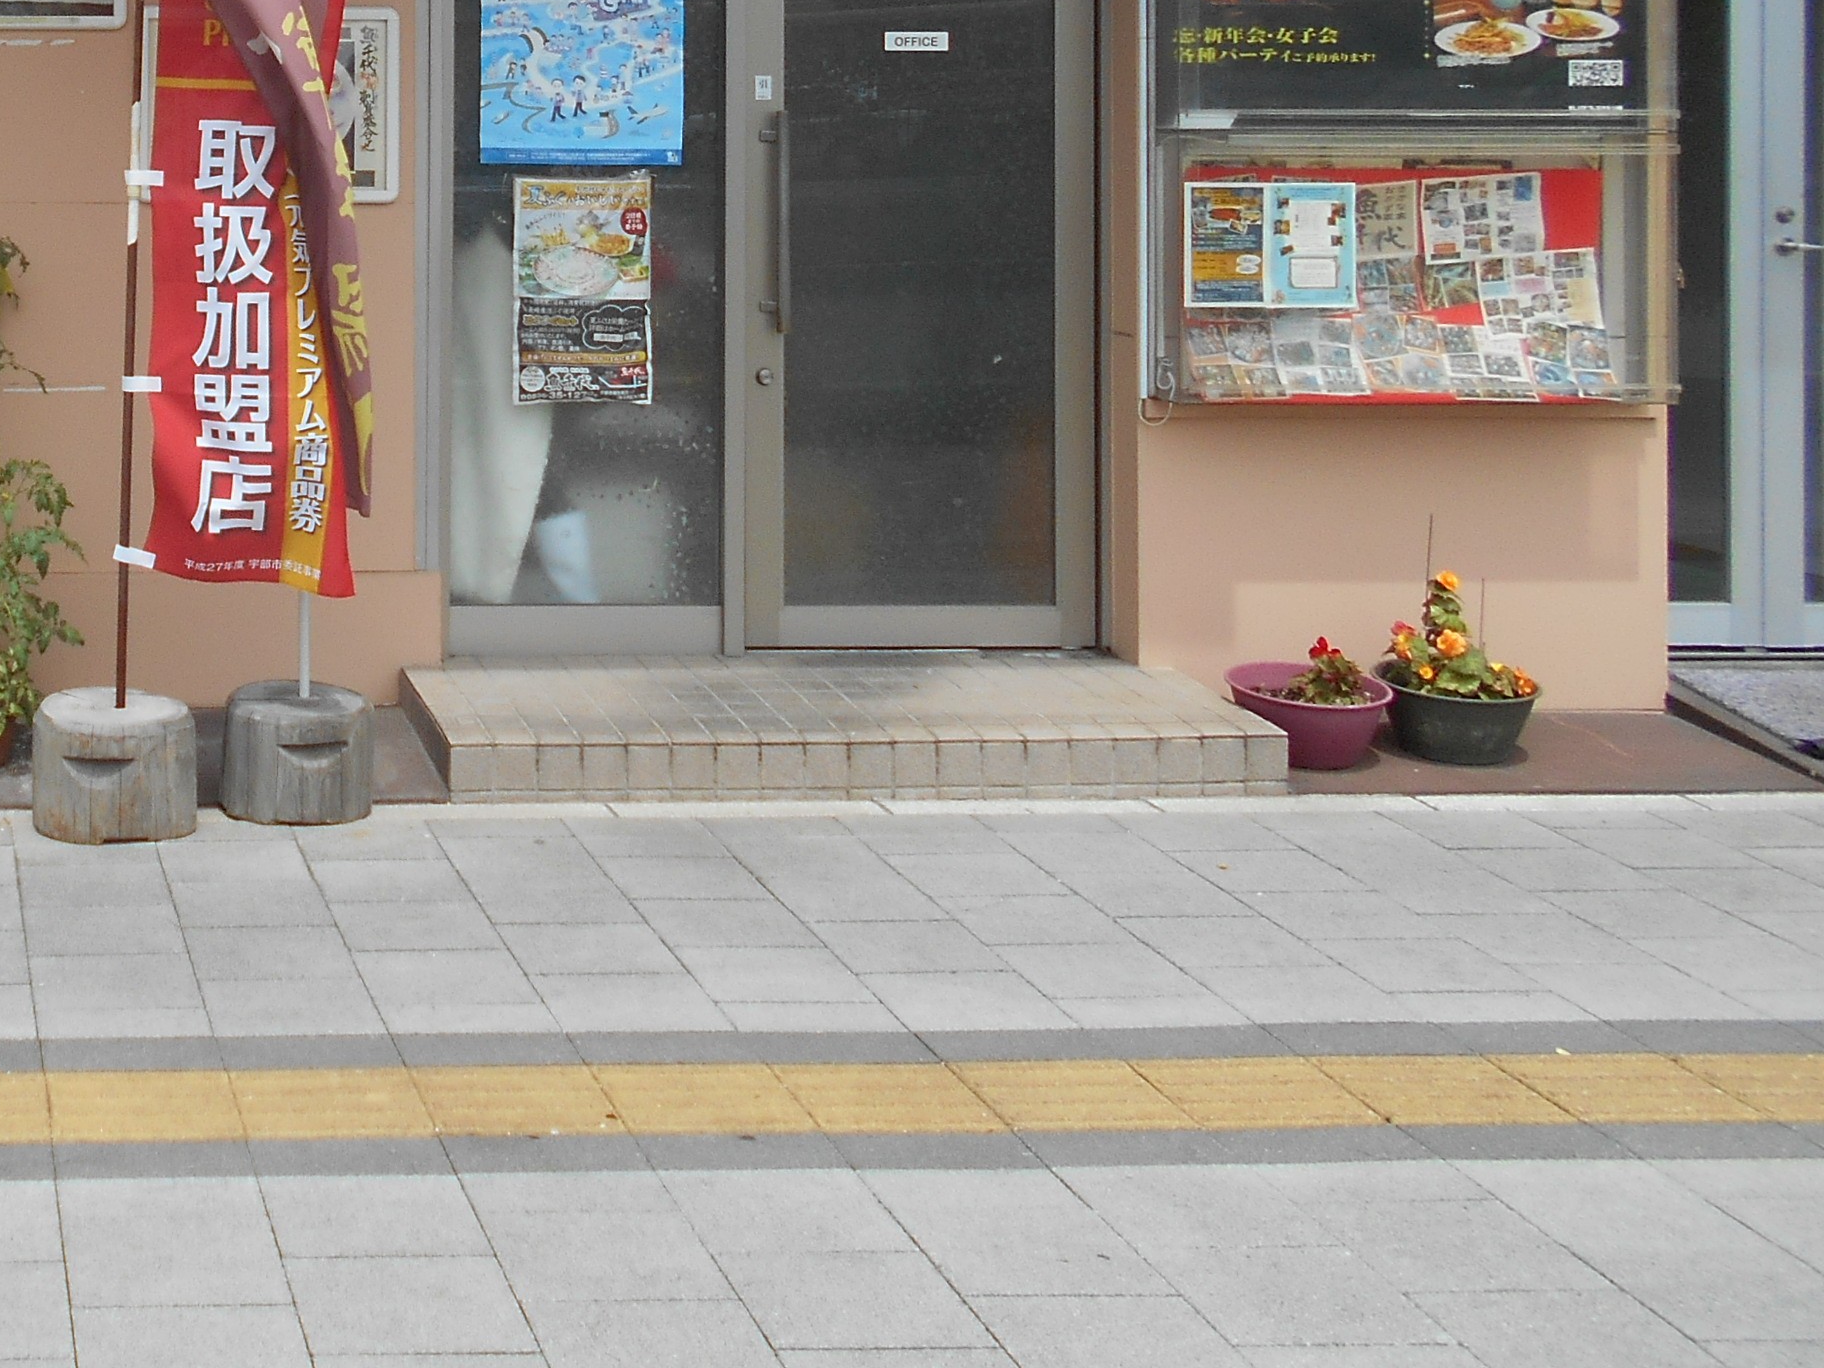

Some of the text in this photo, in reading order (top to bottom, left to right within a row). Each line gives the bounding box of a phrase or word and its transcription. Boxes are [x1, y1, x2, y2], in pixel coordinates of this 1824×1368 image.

[894, 36, 939, 47] OFFICE
[190, 118, 276, 534] 取扱加盟店
[184, 558, 245, 572] 平成27年度
